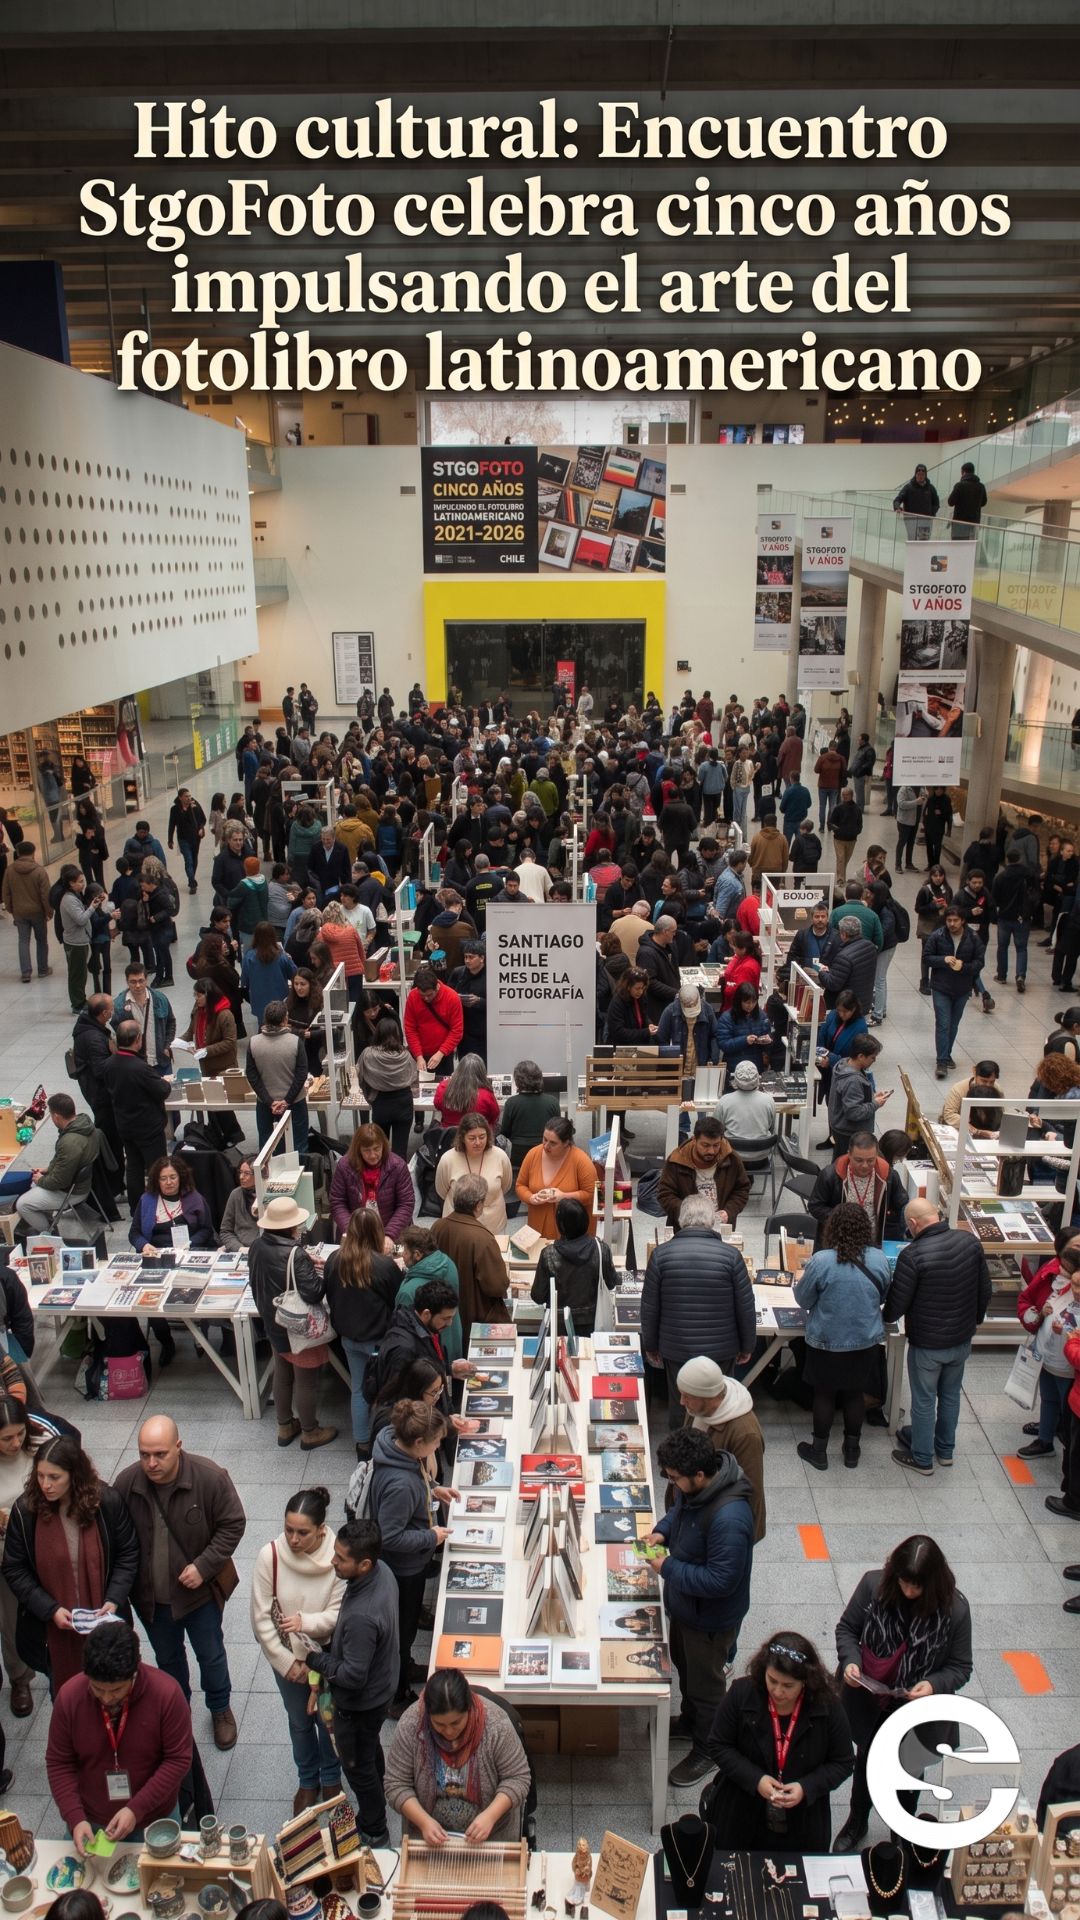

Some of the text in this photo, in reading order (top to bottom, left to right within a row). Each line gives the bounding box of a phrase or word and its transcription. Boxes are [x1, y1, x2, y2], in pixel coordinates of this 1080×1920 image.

[433, 461, 524, 476] STGOFOTO
[433, 480, 524, 496] CINCO AÑOS
[478, 503, 487, 511] EL
[487, 503, 524, 511] FOTOLIBRO
[434, 512, 524, 521] LATINOAMERICANO
[434, 525, 525, 541] 2021-2026
[806, 546, 846, 554] STGOFOTO
[500, 554, 526, 563] CHILE
[809, 554, 844, 565] V AÑOS
[909, 583, 967, 595] STGOFOTO
[912, 595, 962, 611] V AÑOS
[498, 934, 584, 949] SANTIAGO
[498, 953, 549, 967] CHILE
[499, 972, 570, 984] MES DE LA
[499, 985, 584, 999] FOTOGRAFÍA
